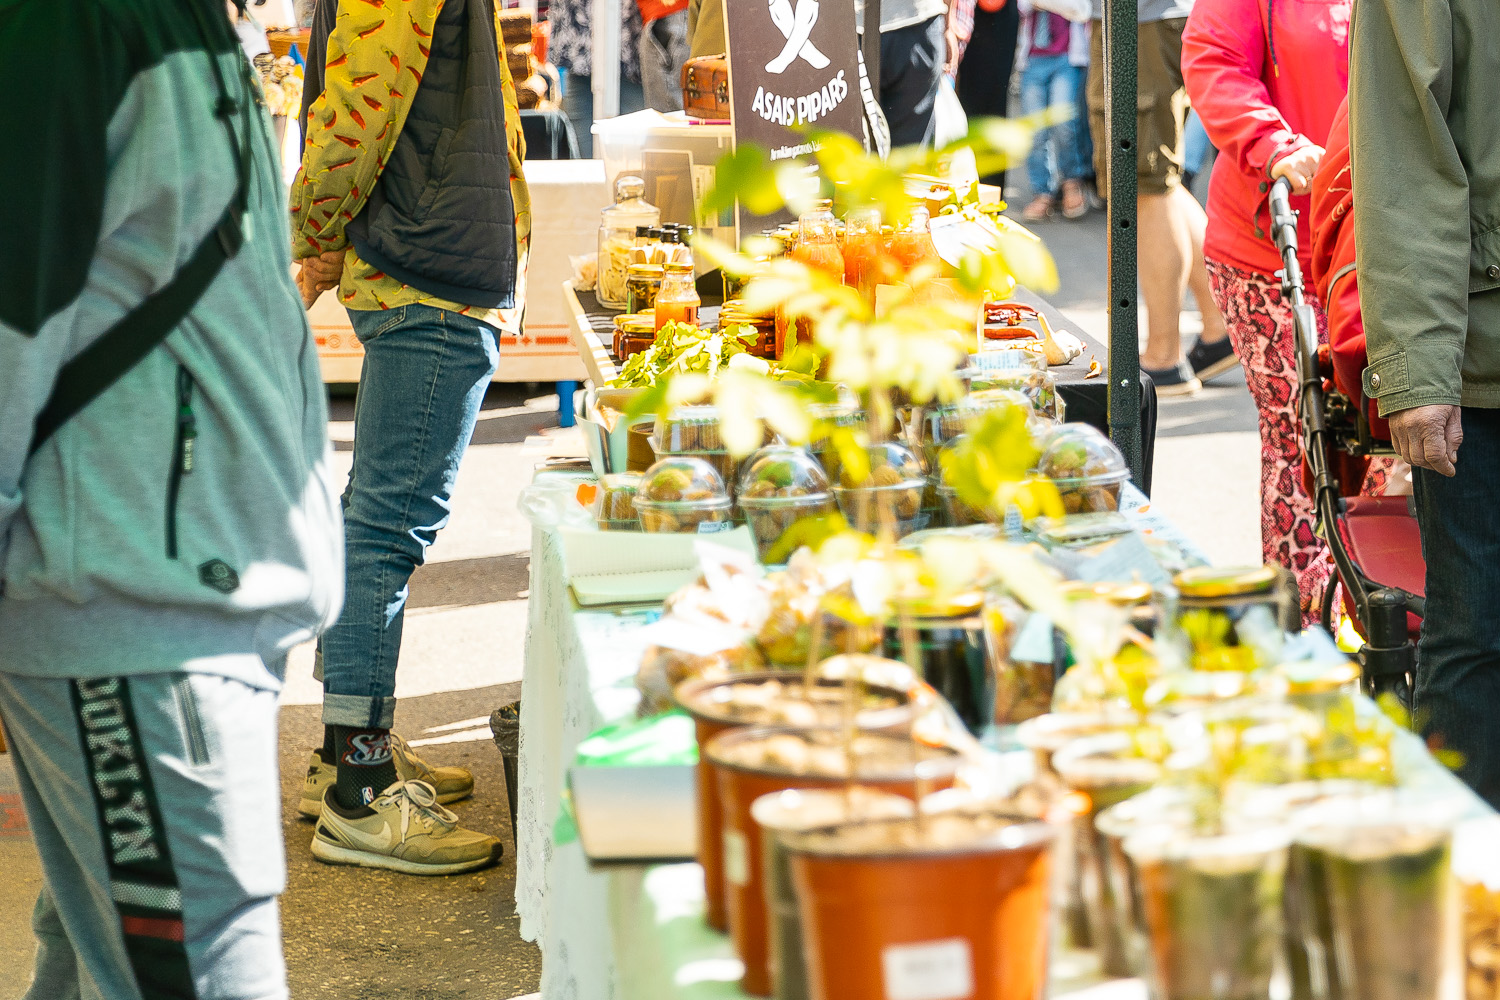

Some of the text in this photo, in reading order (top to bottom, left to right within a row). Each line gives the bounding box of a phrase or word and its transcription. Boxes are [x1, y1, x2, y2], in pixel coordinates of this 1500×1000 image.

[751, 69, 848, 127] ASAIS PIPARS
[76, 677, 160, 865] OOKLYN
